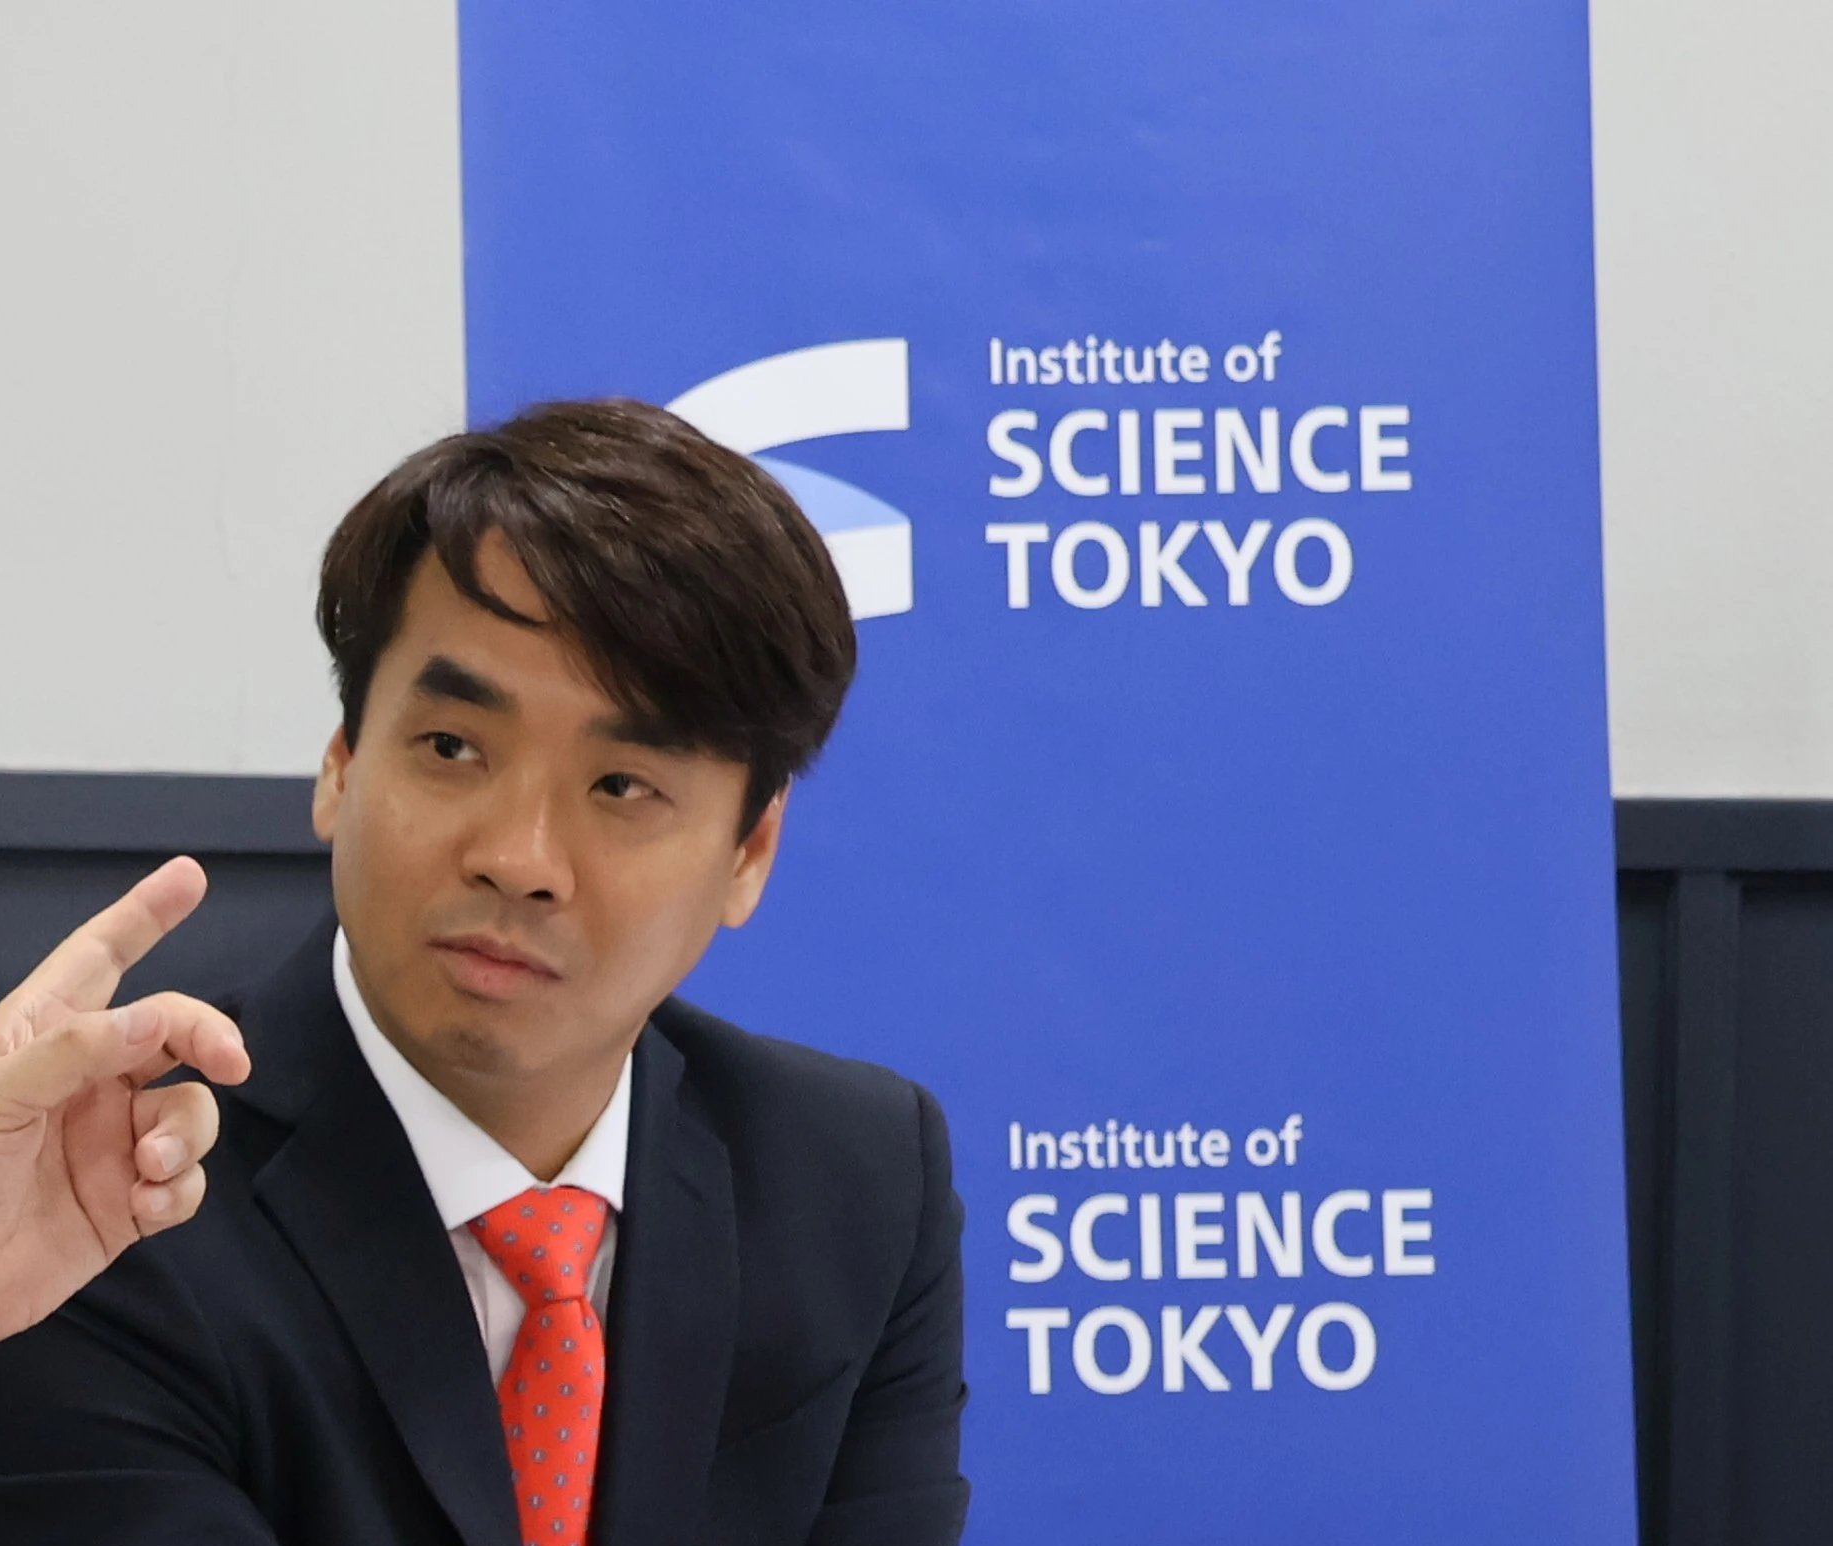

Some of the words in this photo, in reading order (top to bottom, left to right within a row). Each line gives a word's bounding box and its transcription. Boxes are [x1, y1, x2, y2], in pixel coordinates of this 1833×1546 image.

[991, 336, 1209, 384] Institute
[1225, 332, 1281, 382] of
[988, 406, 1411, 497] SCIENCE
[986, 519, 1352, 608] TOKYO
[1010, 1120, 1229, 1168] Institute
[1246, 1115, 1301, 1165] of
[1008, 1190, 1434, 1282] SCIENCE
[1007, 1303, 1375, 1393] TOKYO
